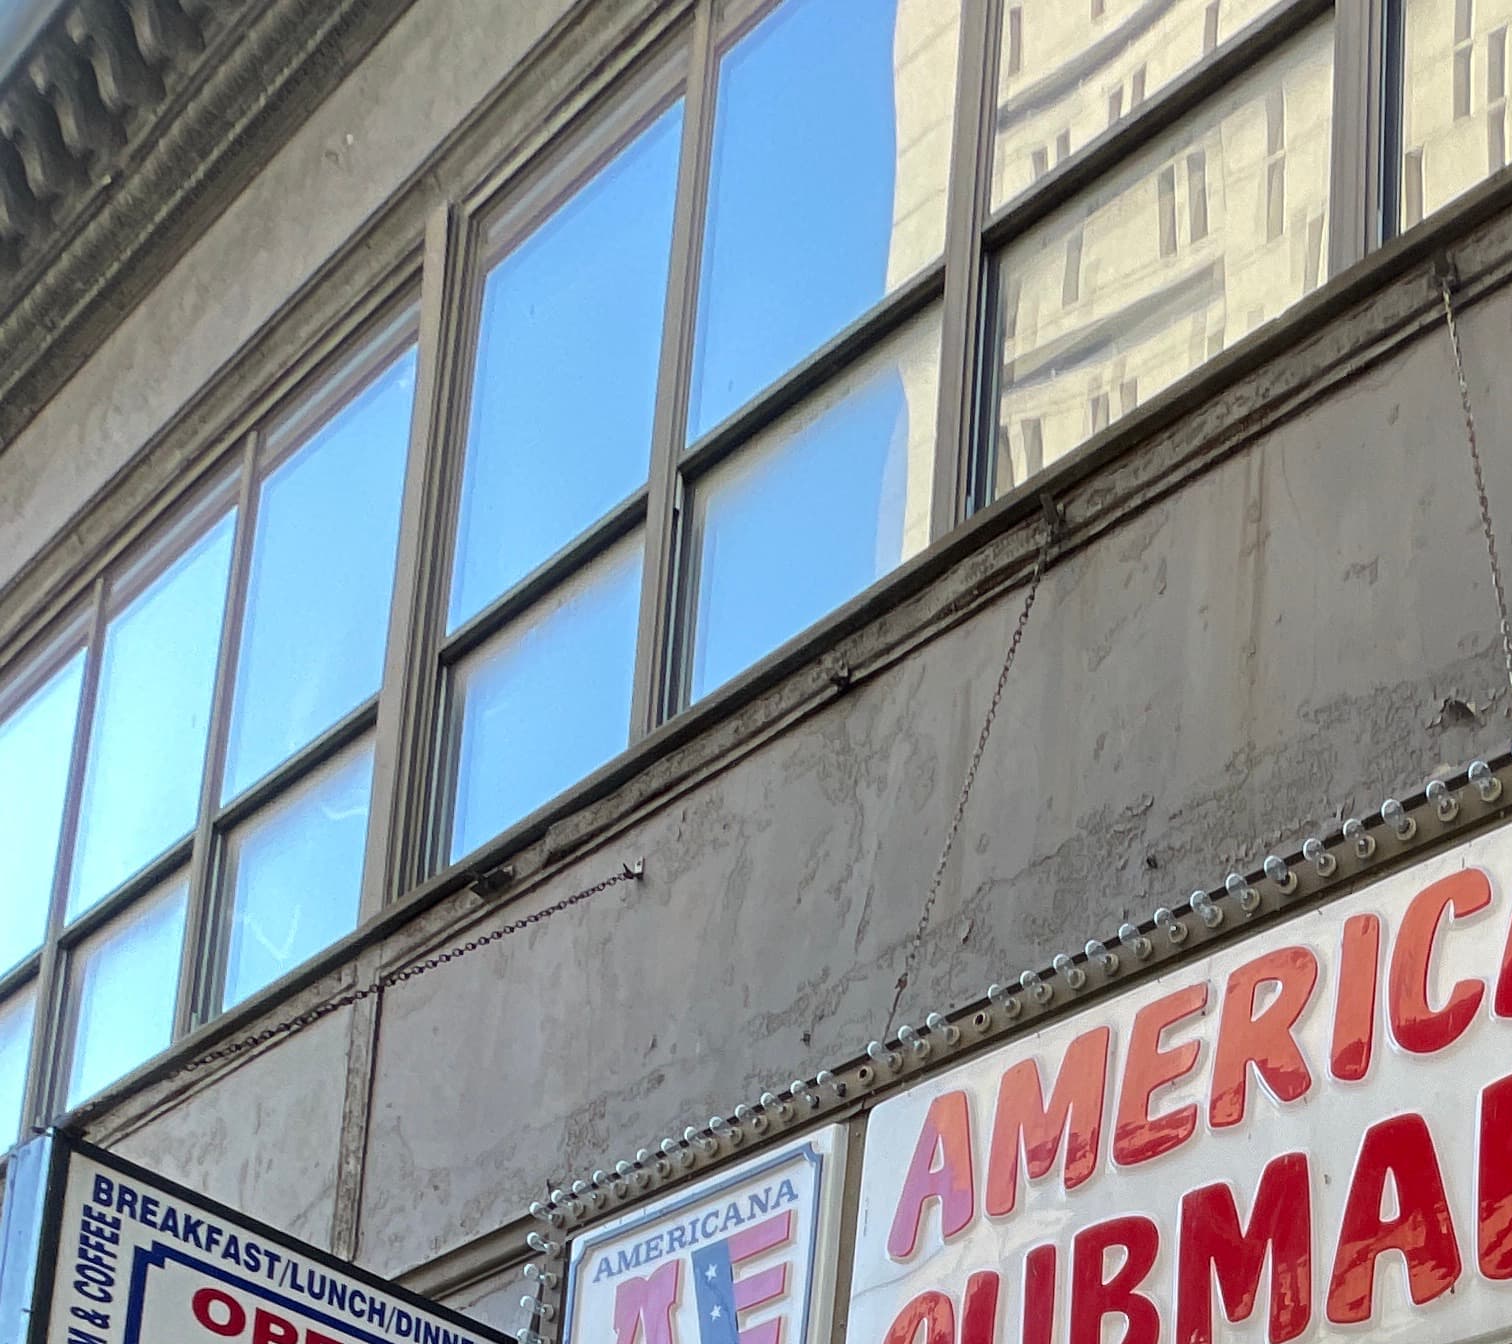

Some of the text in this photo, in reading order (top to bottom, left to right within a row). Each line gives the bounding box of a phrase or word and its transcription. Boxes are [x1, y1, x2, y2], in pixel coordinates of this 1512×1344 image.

[74, 1204, 122, 1303] COFFEE
[592, 1178, 798, 1283] AMERICANA
[90, 1306, 111, 1329] &
